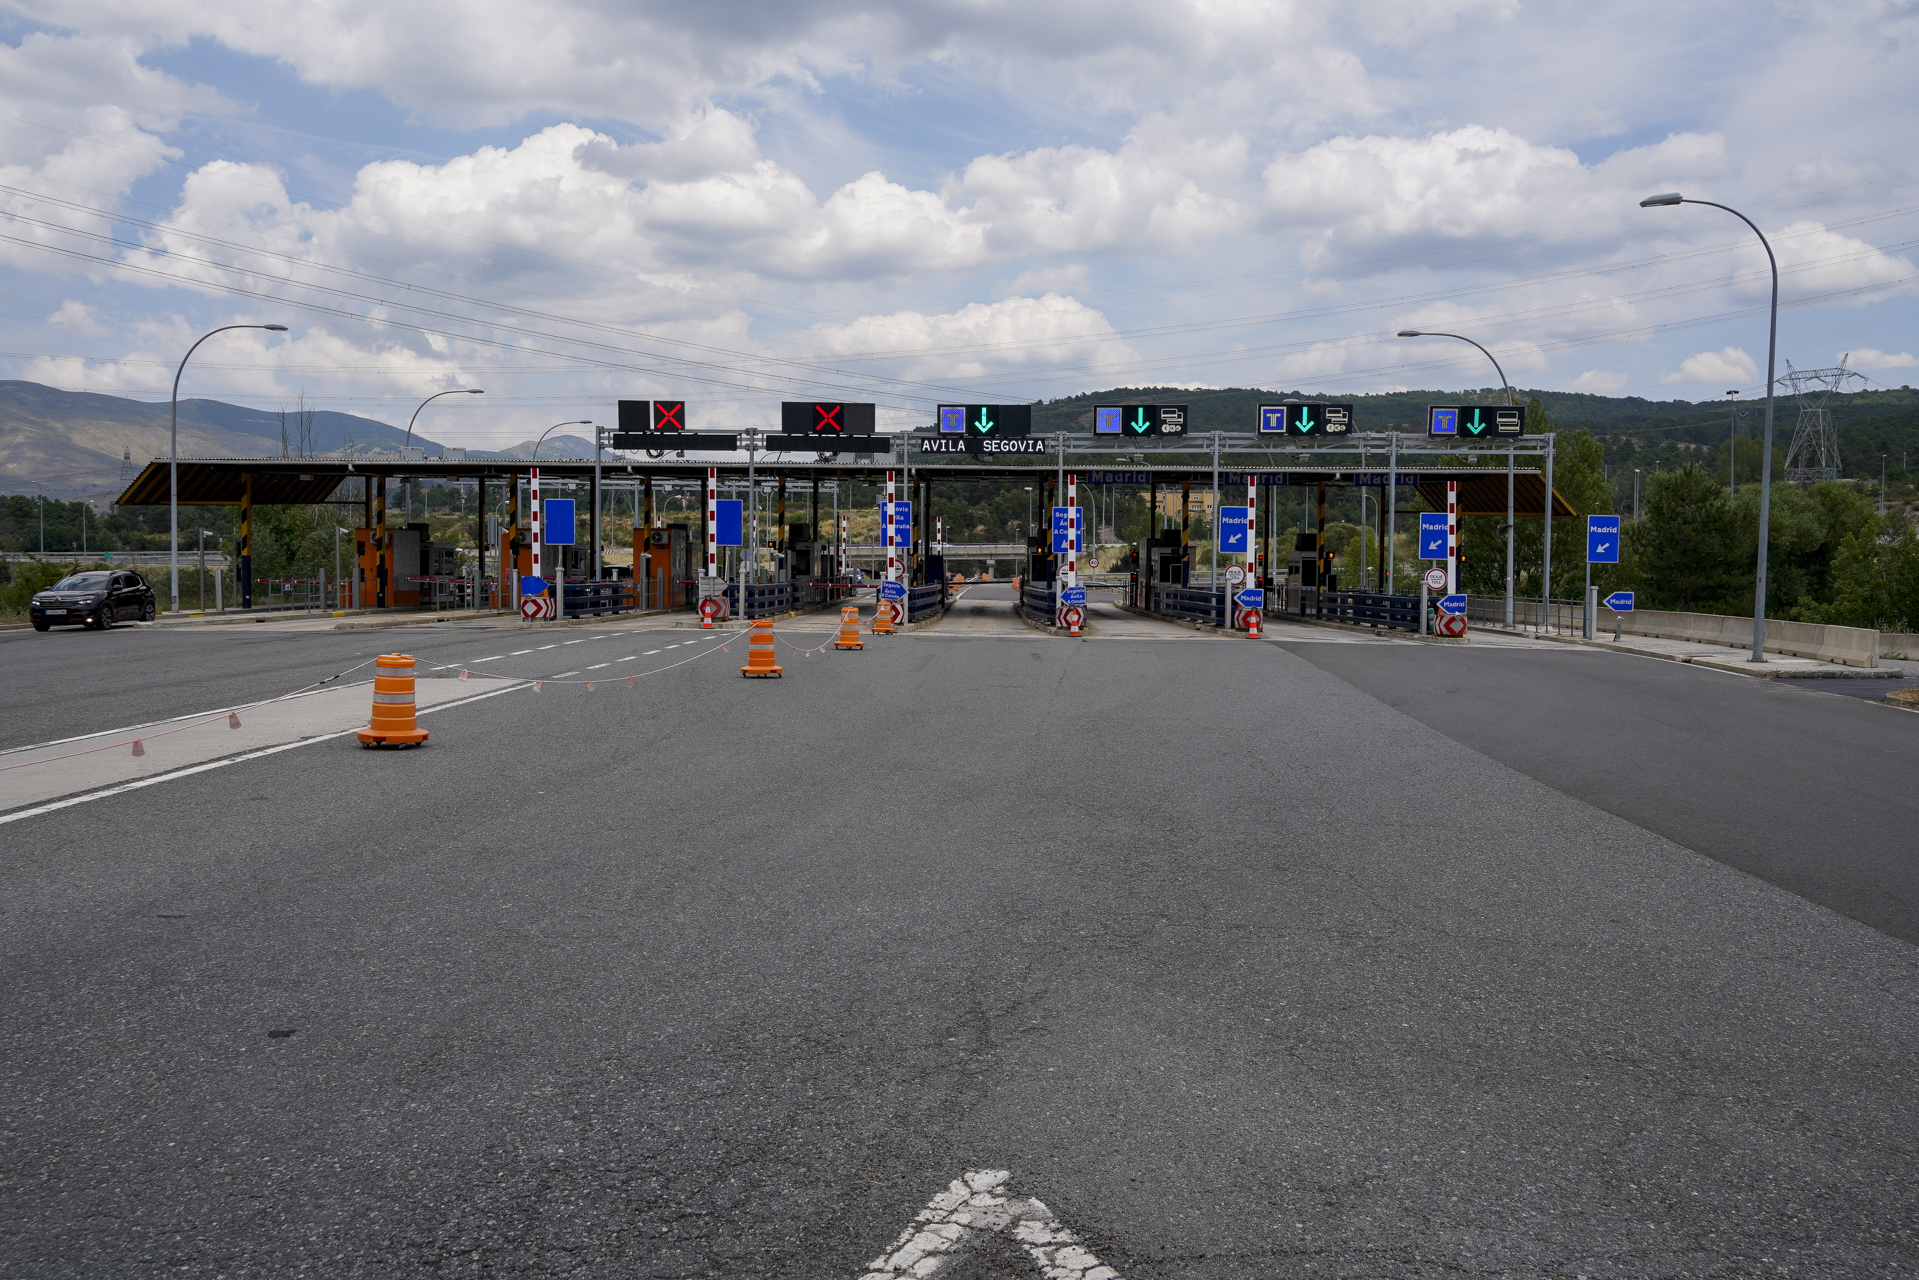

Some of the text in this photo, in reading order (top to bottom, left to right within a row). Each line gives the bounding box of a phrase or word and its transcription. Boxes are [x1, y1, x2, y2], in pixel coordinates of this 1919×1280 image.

[922, 440, 1044, 452] AVILA SEGOVIA
[1092, 470, 1146, 482] Madrid
